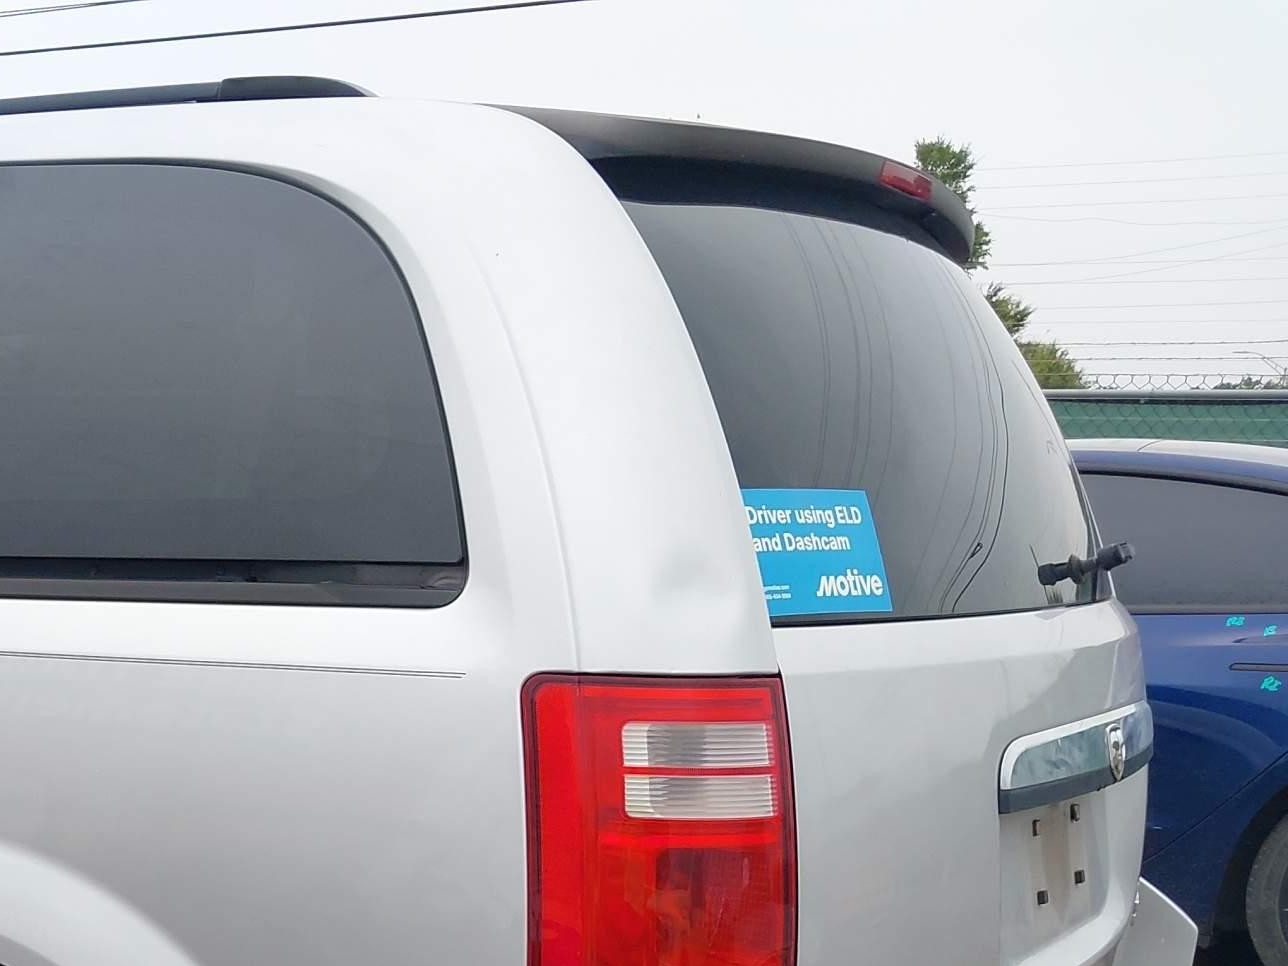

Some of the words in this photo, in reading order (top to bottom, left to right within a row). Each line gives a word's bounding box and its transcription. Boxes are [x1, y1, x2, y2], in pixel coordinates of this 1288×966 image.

[746, 506, 793, 525] Driver
[795, 505, 834, 529] using
[836, 506, 862, 525] ELD
[753, 533, 783, 552] and
[783, 532, 851, 552] Dashcam
